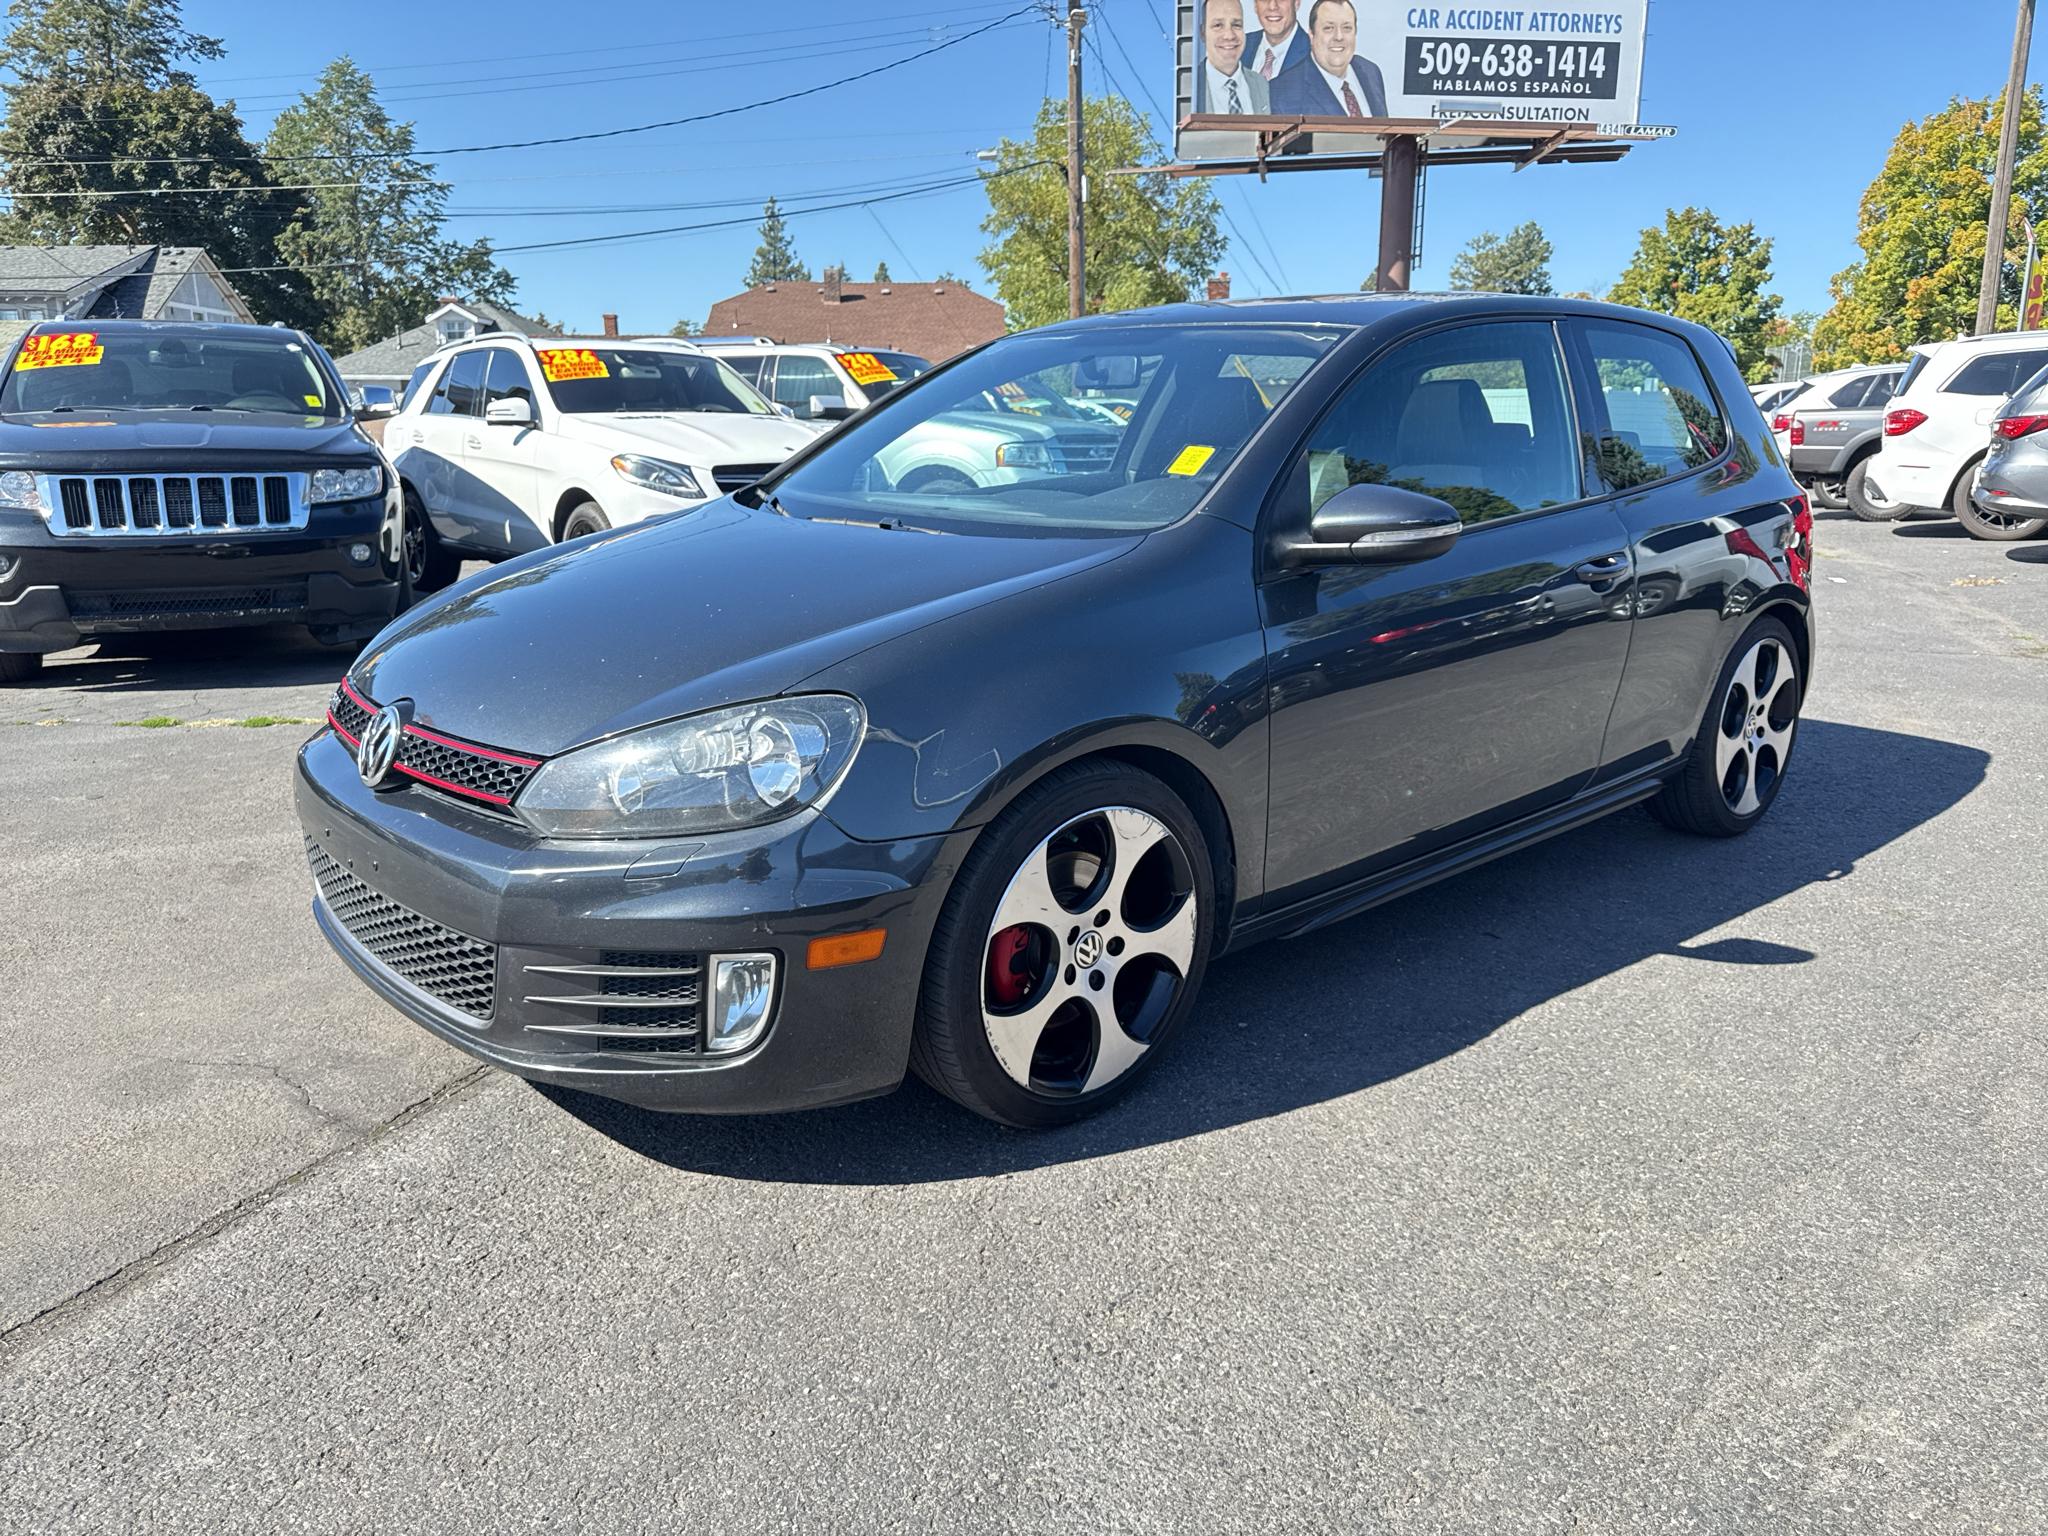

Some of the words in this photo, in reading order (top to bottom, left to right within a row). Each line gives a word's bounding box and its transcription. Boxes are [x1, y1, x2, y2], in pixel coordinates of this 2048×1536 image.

[1407, 8, 1440, 29] CAR
[1446, 10, 1524, 32] ACCIDENT
[1529, 12, 1623, 34] ATTORNEYS
[1418, 42, 1606, 78] 509-638-1414
[1433, 79, 1518, 93] HABLAMOS
[1524, 80, 1592, 94] ESPAÑOL
[1630, 126, 1673, 137] LAMAR
[27, 333, 95, 352] $168
[55, 346, 98, 354] MONTH
[539, 350, 598, 364] $286
[22, 352, 99, 363] LEATHER
[550, 366, 603, 375] LEATHER
